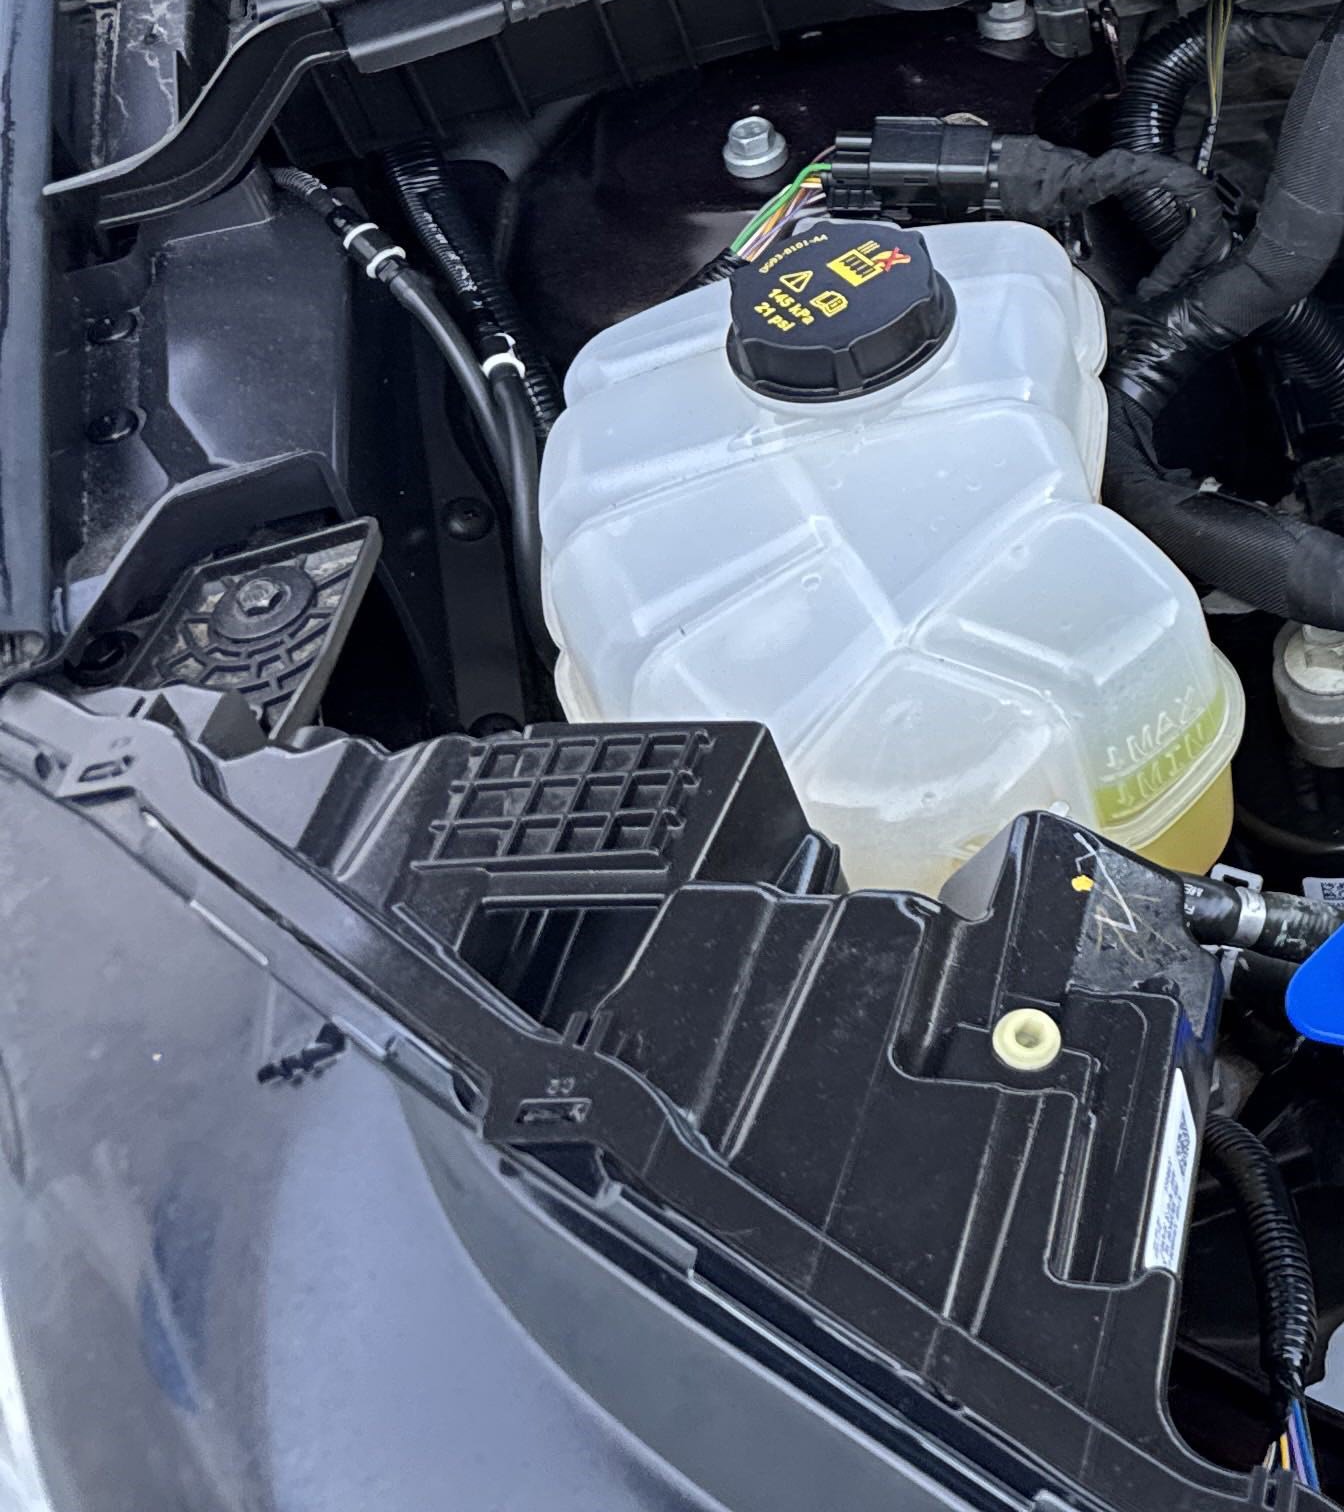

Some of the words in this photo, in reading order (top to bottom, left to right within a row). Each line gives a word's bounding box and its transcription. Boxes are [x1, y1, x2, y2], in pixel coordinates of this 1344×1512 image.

[754, 302, 776, 318] 21
[767, 314, 796, 332] psi
[768, 289, 795, 307] 145
[788, 303, 815, 326] kPa
[1126, 686, 1200, 762] MAX
[1137, 723, 1204, 799] MIN
